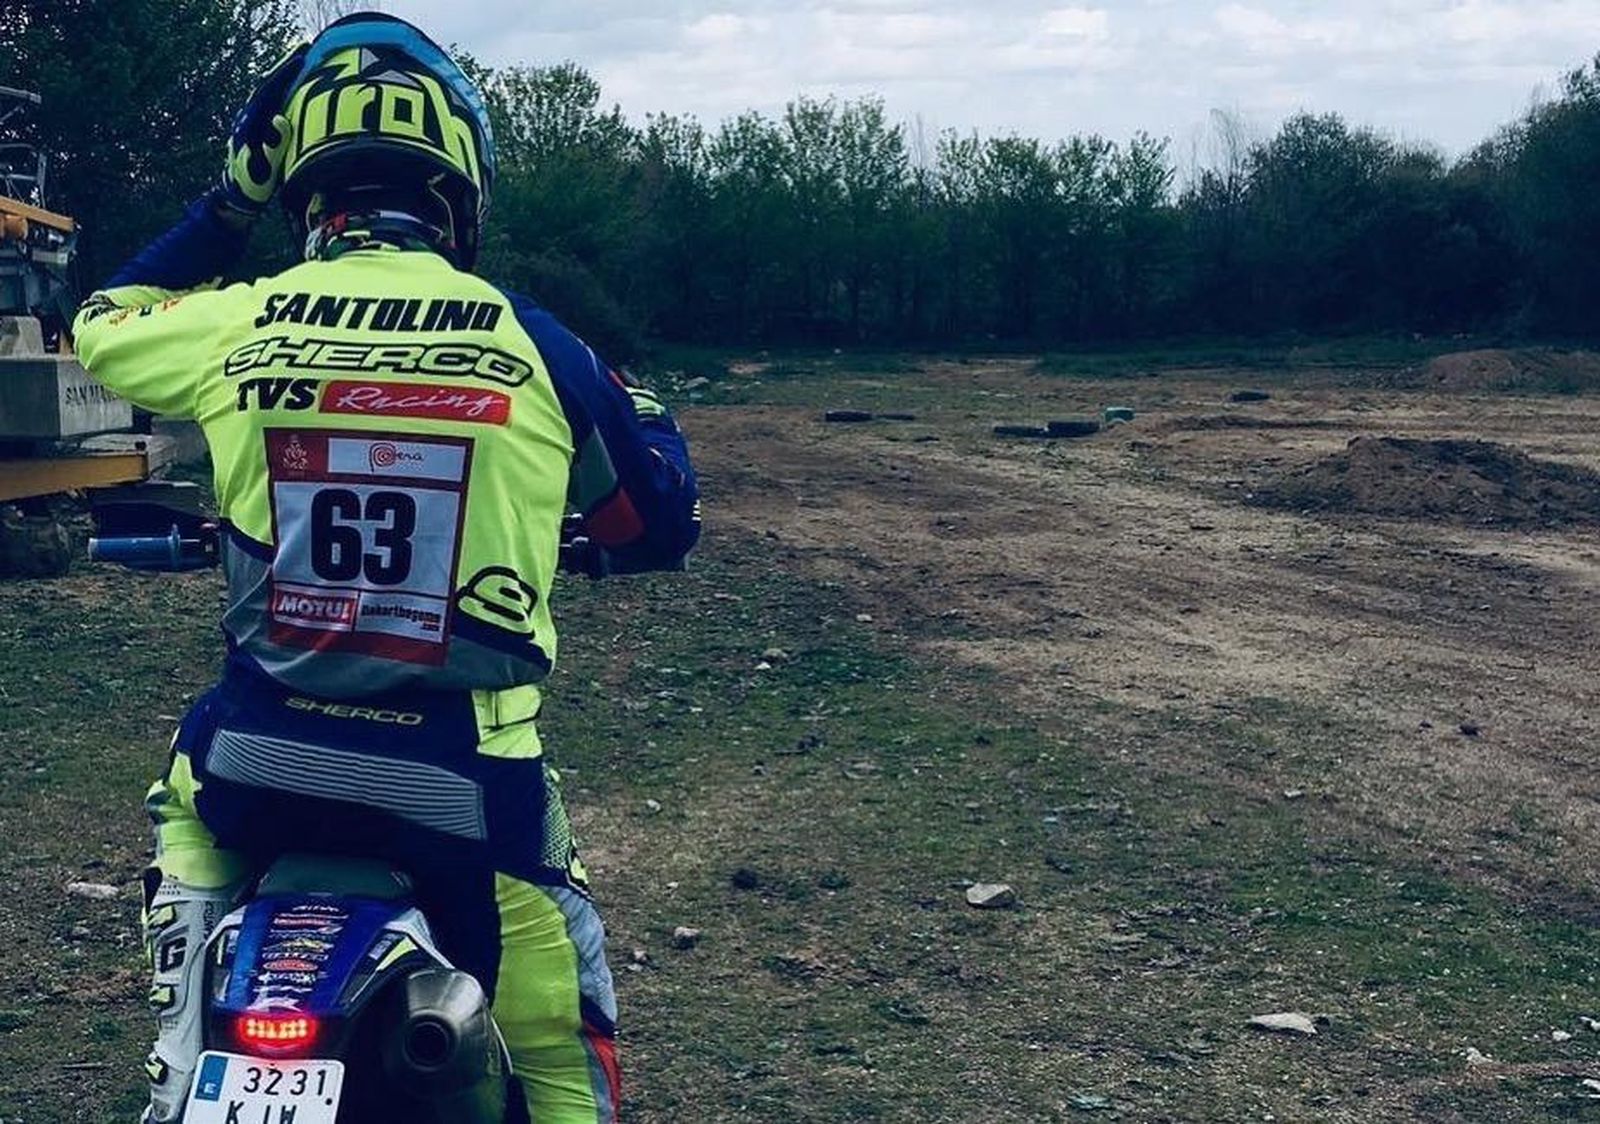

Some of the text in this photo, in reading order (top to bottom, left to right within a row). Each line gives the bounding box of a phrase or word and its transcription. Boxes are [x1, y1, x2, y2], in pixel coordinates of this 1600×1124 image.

[254, 293, 503, 333] SANTOLINO
[225, 336, 533, 388] SHERCO
[236, 377, 506, 416] TVS Racing
[311, 488, 416, 586] 63
[277, 594, 350, 619] MOTUL
[285, 698, 425, 726] SHERCO
[243, 1066, 327, 1097] 3231
